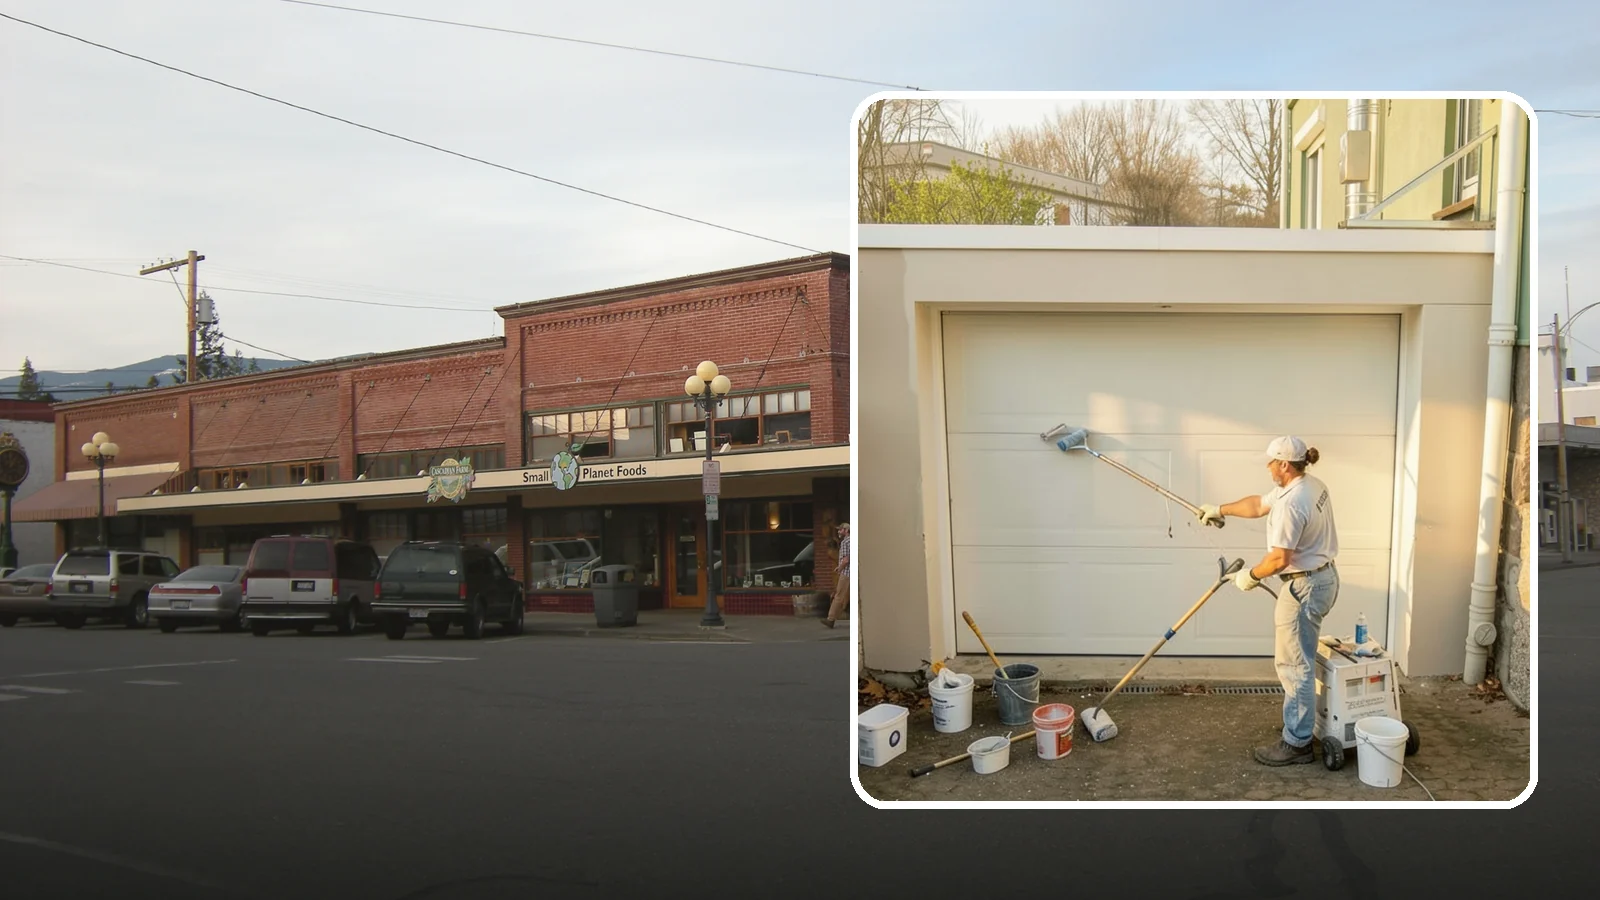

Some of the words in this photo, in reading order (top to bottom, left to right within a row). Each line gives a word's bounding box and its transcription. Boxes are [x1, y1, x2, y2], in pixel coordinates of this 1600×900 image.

[523, 471, 549, 483] Small
[583, 468, 614, 479] Planet
[617, 464, 647, 477] Foods
